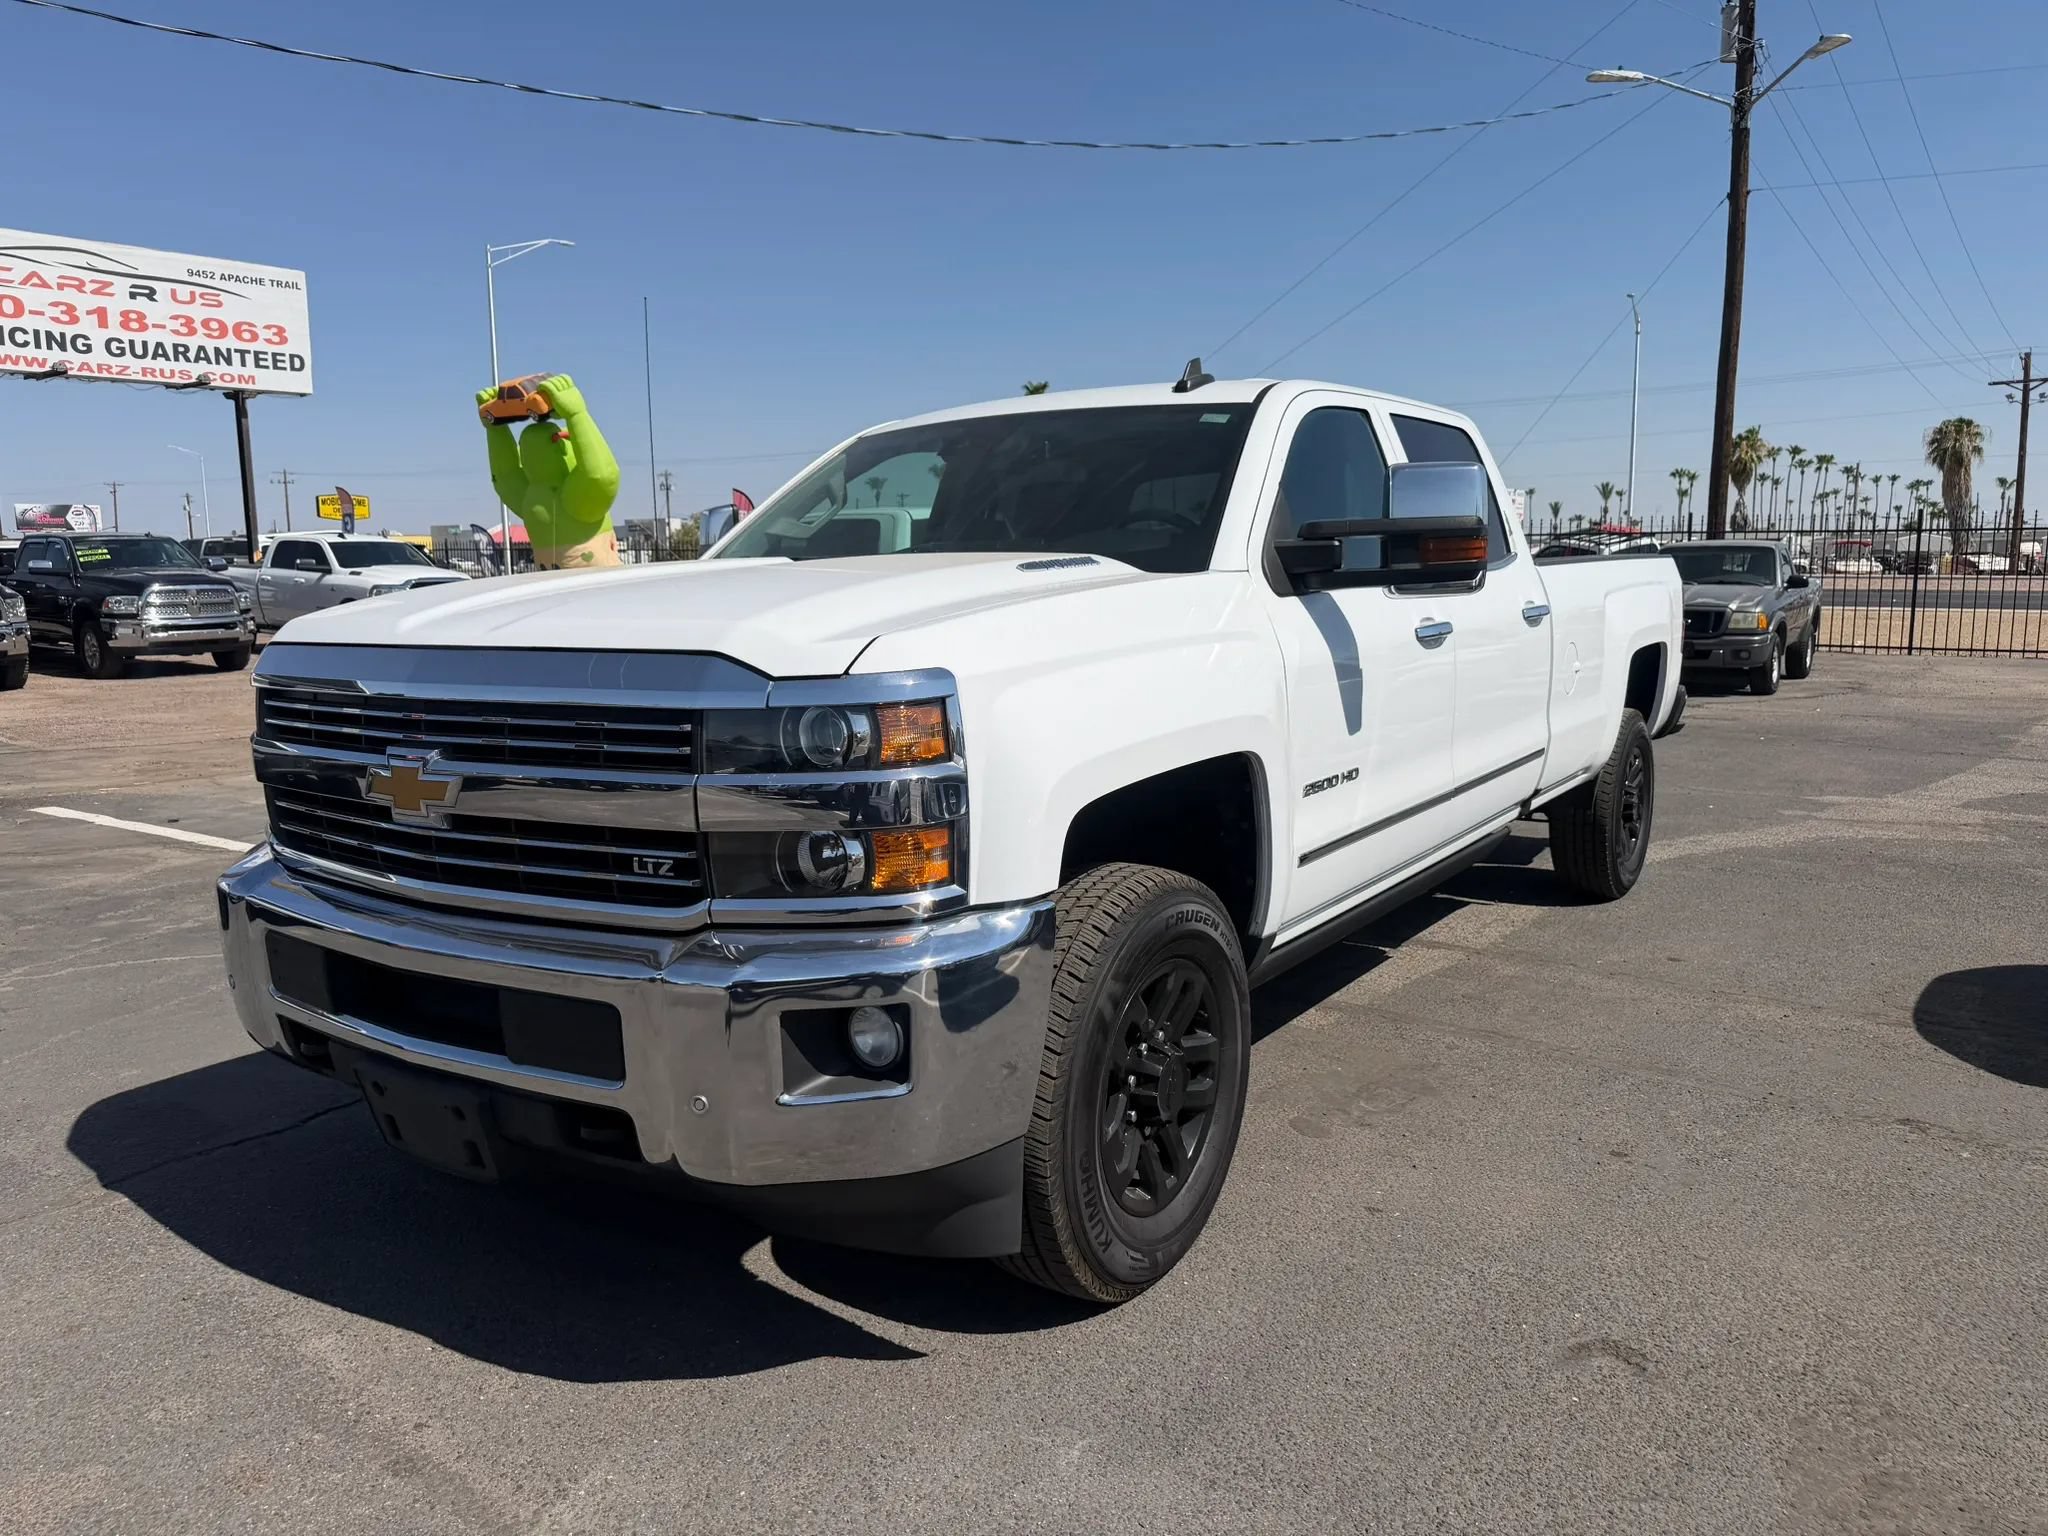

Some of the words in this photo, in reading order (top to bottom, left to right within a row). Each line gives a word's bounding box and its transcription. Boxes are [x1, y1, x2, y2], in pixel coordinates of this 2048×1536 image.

[186, 268, 216, 280] 9452
[220, 273, 266, 287] APACHE
[269, 279, 302, 291] TRAIL
[129, 283, 159, 303] R
[170, 288, 224, 309] US
[104, 337, 306, 372] GUARANTEED
[1302, 773, 1340, 798] 2500
[1340, 767, 1360, 785] HD
[633, 857, 675, 877] LTZ
[1080, 1150, 1113, 1254] KUMHO
